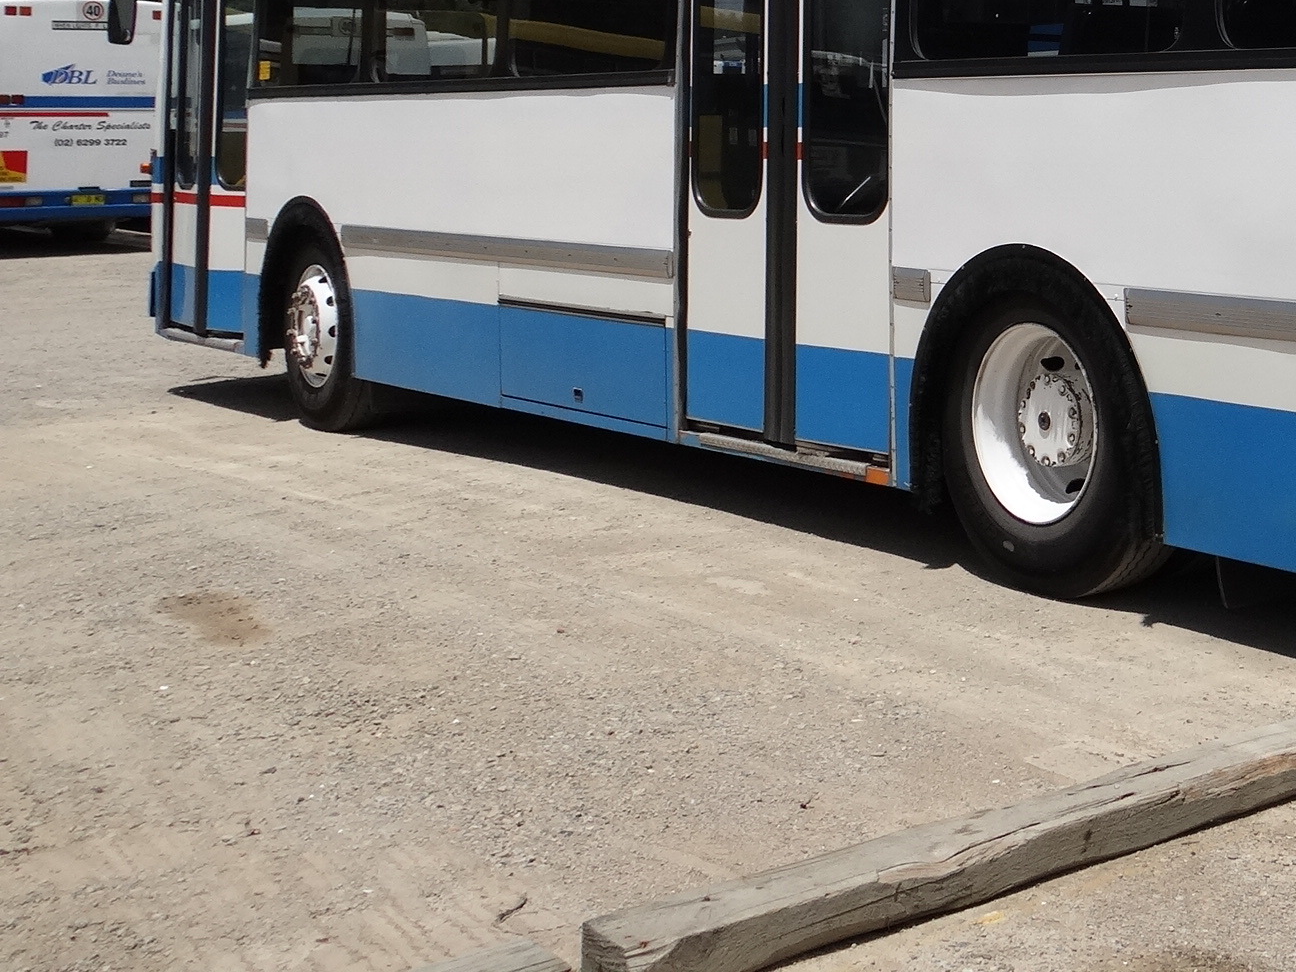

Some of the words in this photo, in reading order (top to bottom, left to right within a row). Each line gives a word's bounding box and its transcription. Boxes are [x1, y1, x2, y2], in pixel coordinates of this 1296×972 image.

[86, 5, 100, 17] 40
[30, 120, 49, 131] The
[52, 120, 93, 132] Charter
[54, 138, 73, 147] (02)
[76, 138, 101, 147] 6299
[104, 138, 128, 146] 3722
